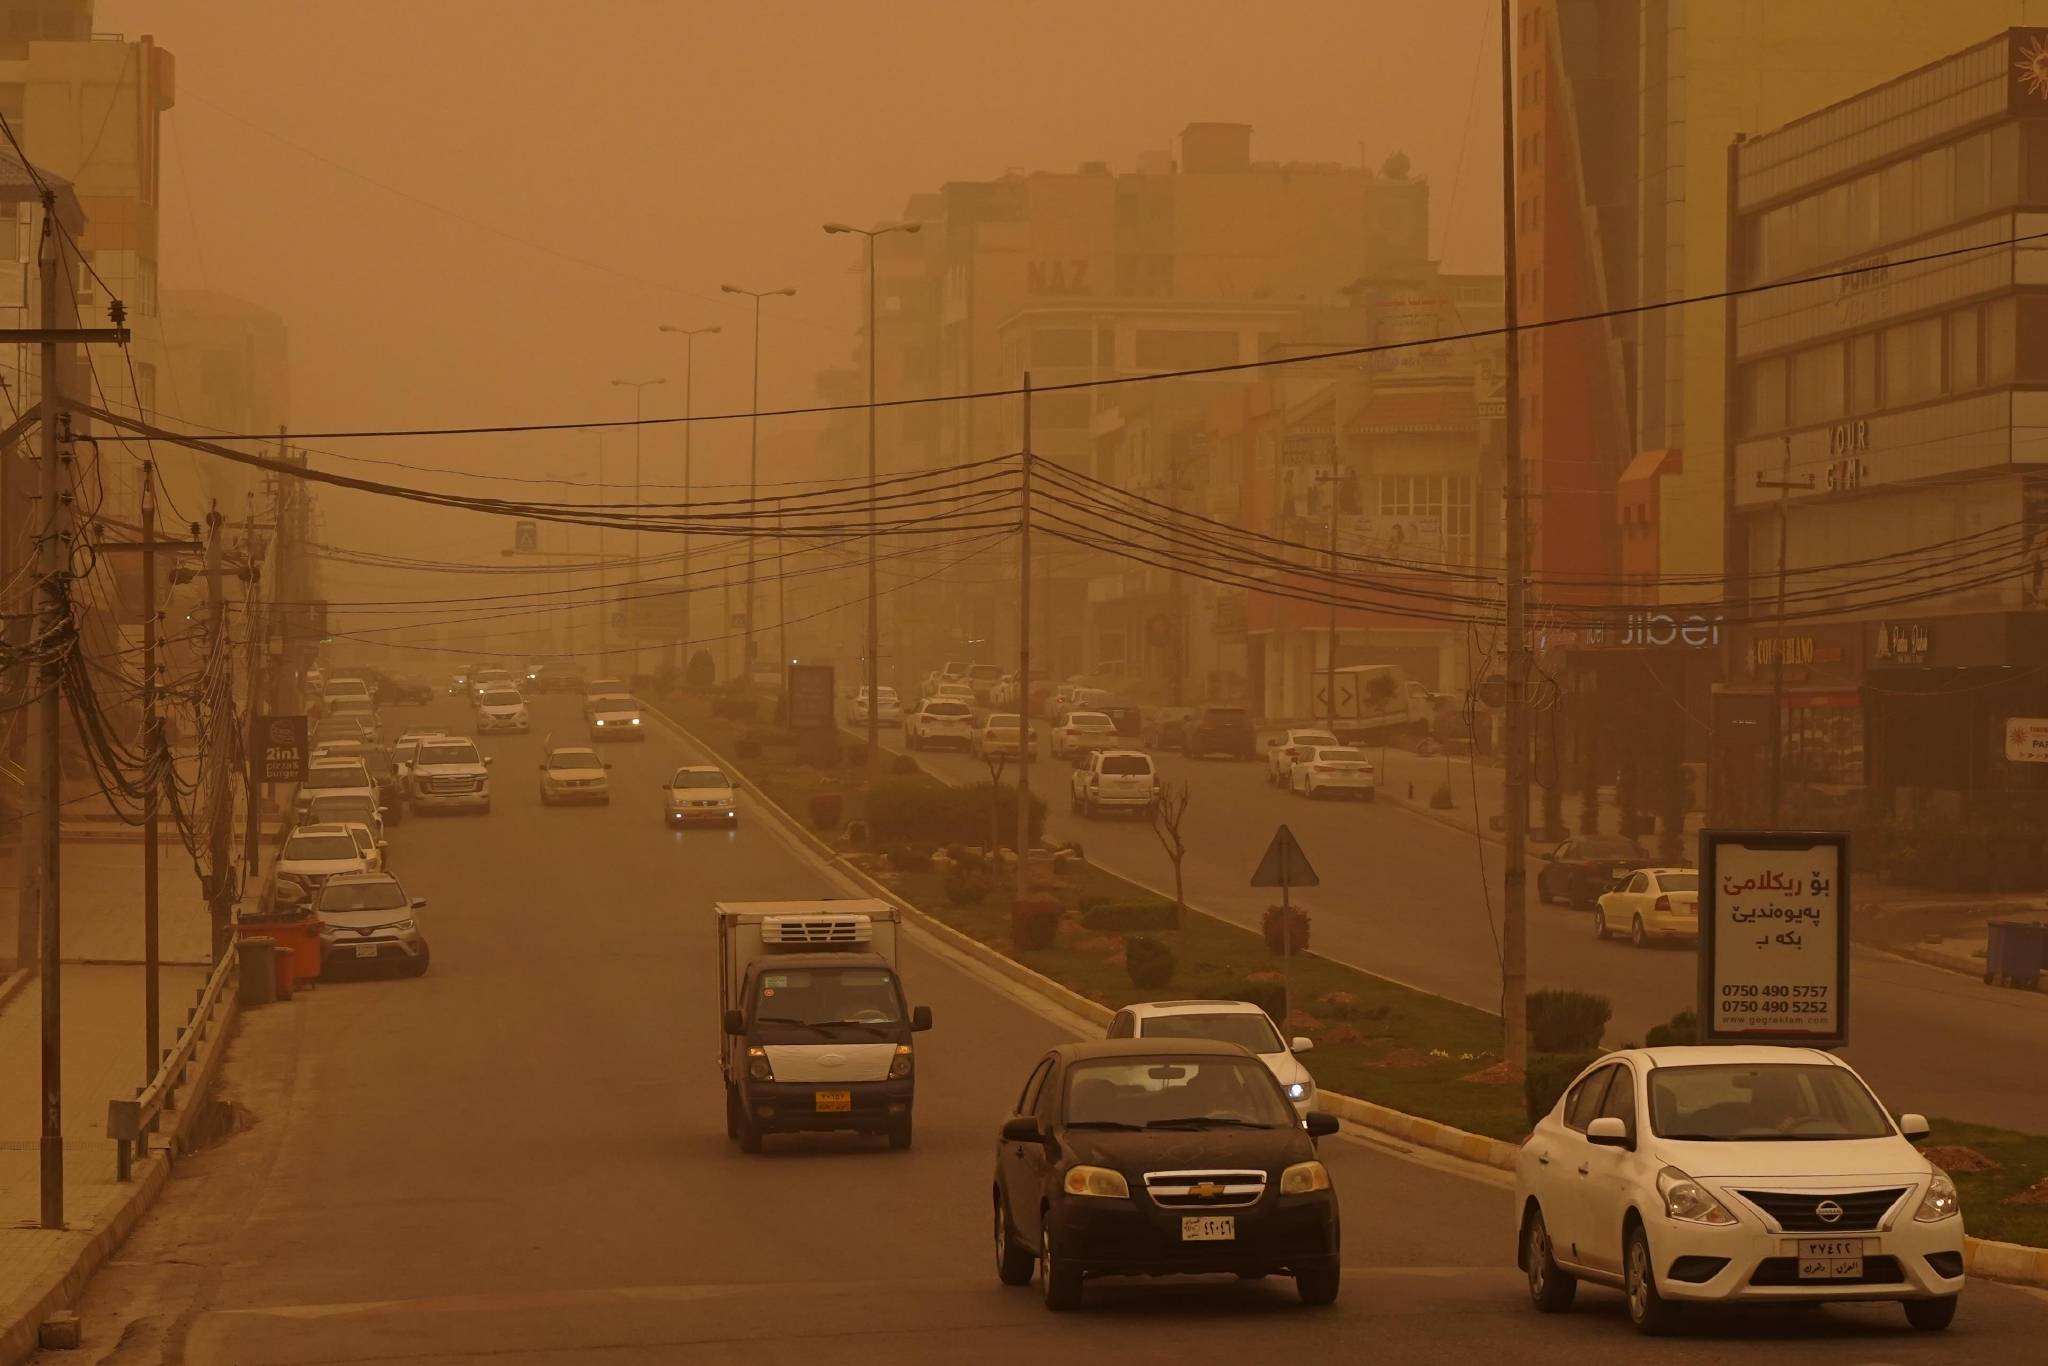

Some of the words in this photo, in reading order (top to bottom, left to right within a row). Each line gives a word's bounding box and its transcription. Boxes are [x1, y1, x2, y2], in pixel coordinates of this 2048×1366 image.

[1028, 260, 1089, 293] NAZ
[1842, 255, 1888, 293] POWER
[1827, 420, 1867, 457] YOUR
[1826, 459, 1858, 492] GYM
[1757, 637, 1813, 665] COLBIANO
[266, 747, 300, 760] 2in1
[266, 770, 299, 779] burger
[1810, 871, 1830, 896] بۆ
[1722, 985, 1758, 997] 0750
[1762, 985, 1789, 997] 490
[1792, 985, 1828, 998] 5757
[1722, 1001, 1758, 1013] 0750
[1762, 1001, 1789, 1013] 490
[1792, 1001, 1828, 1013] 5252
[1809, 1242, 1851, 1255] ٣٧٤٢٢
